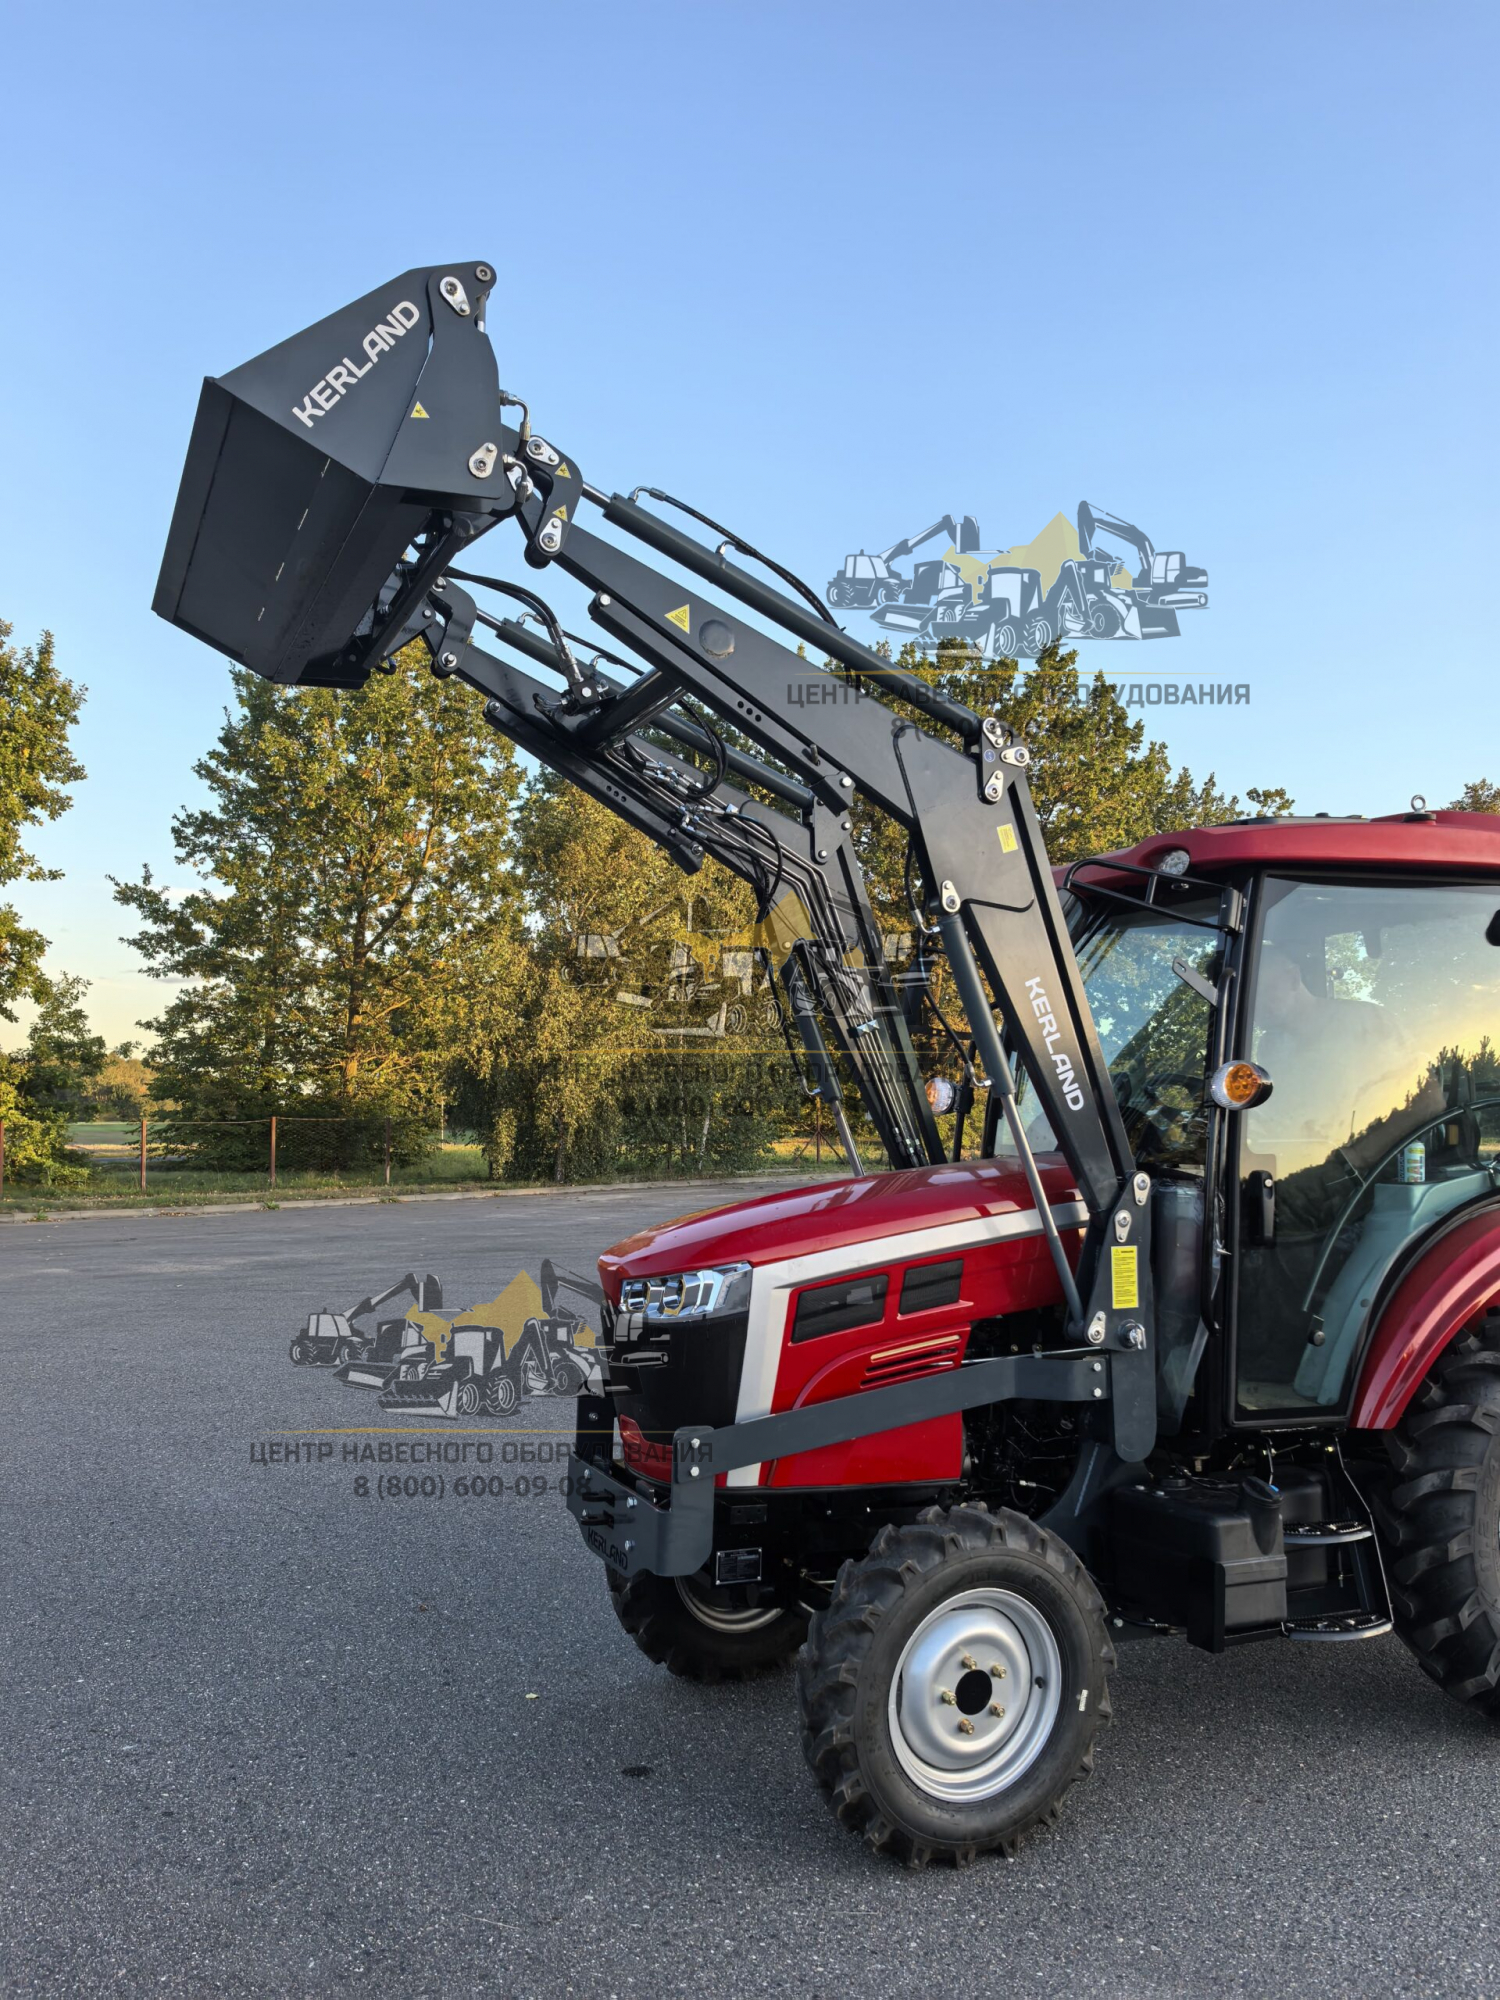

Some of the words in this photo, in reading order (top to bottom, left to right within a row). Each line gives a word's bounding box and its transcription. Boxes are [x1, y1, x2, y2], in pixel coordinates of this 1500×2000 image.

[292, 301, 420, 428] KERLAND
[1024, 976, 1084, 1111] KERLAND
[587, 1527, 628, 1570] KERLAND
